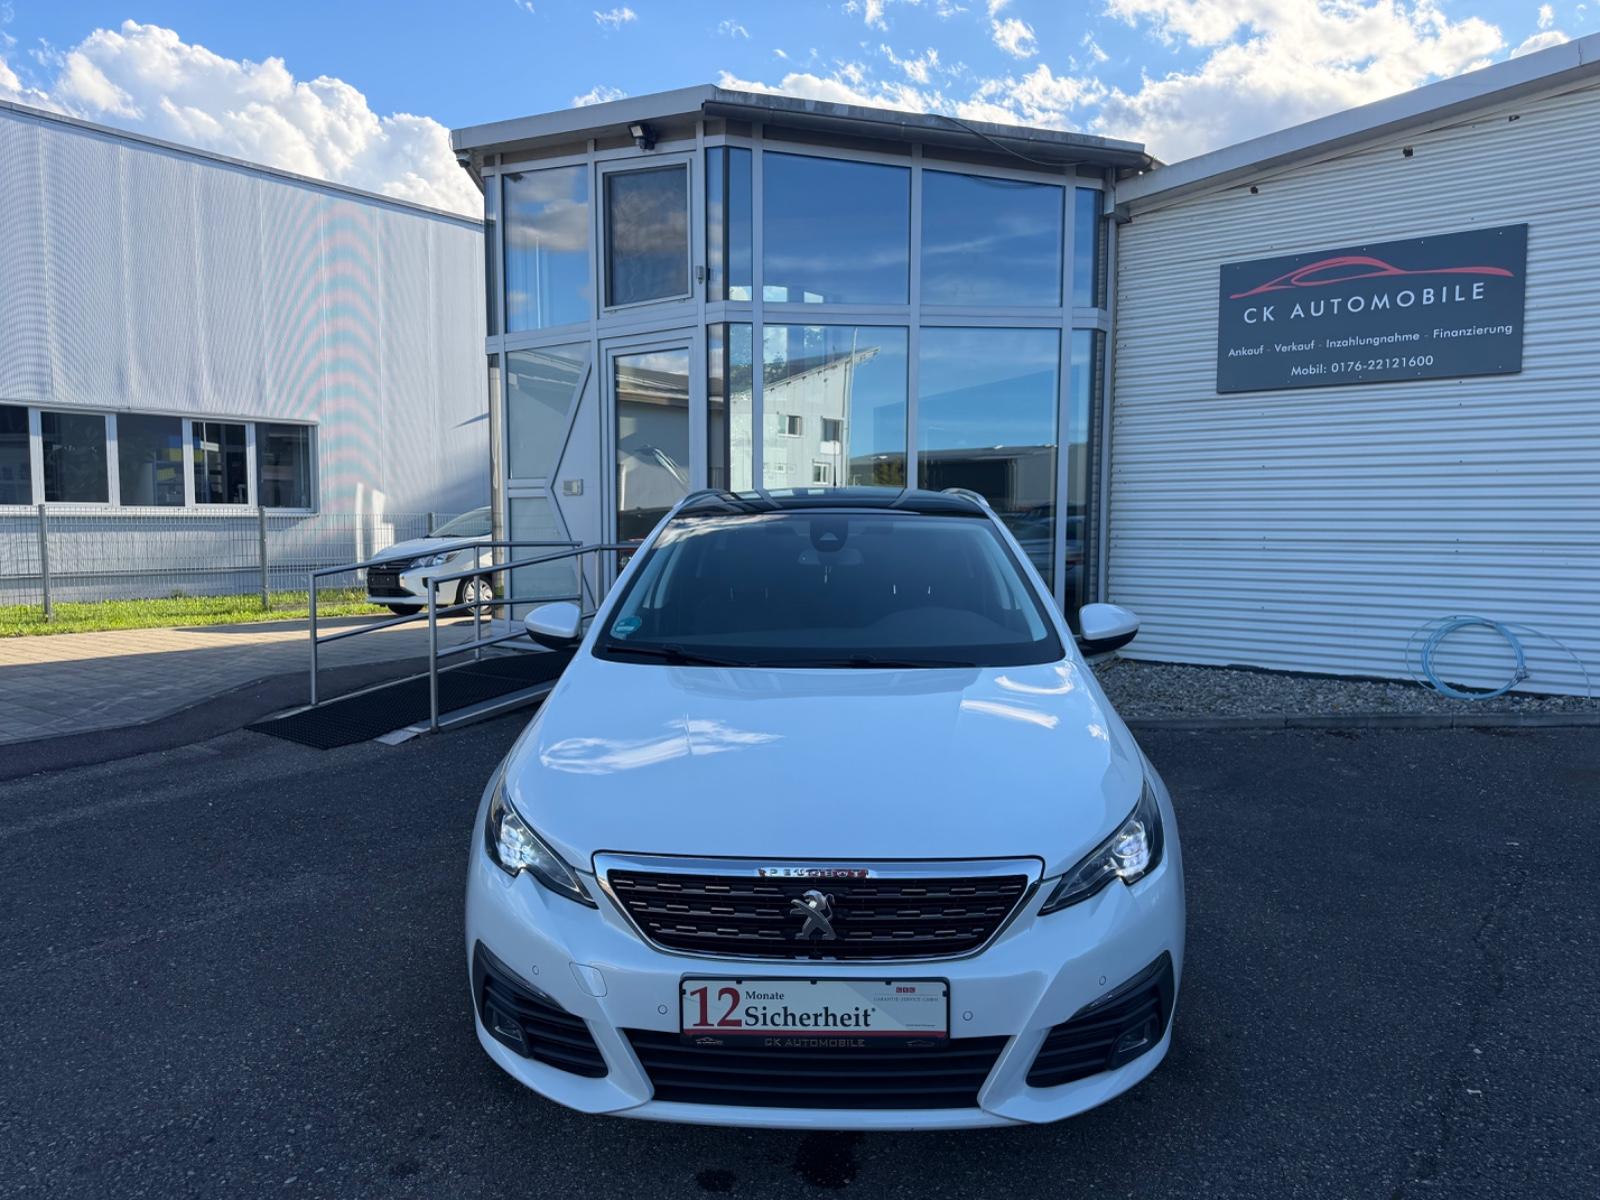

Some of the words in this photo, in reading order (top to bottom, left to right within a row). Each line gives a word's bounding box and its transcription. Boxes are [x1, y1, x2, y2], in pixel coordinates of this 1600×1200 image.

[1243, 306, 1275, 324] CK
[1290, 282, 1485, 319] AUTOMOBILE
[1228, 345, 1264, 357] Ankauf
[1274, 340, 1315, 353] Verkauf
[1326, 332, 1420, 348] Inzahlungnahme
[1433, 325, 1513, 340] Finanzierung
[1291, 364, 1327, 376] Mobil:
[1331, 355, 1434, 373] 0176-22121600
[689, 986, 742, 1027] 12
[745, 991, 785, 1001] Monate
[765, 1037, 781, 1047] CK
[785, 1039, 866, 1048] AUTOMOBILE
